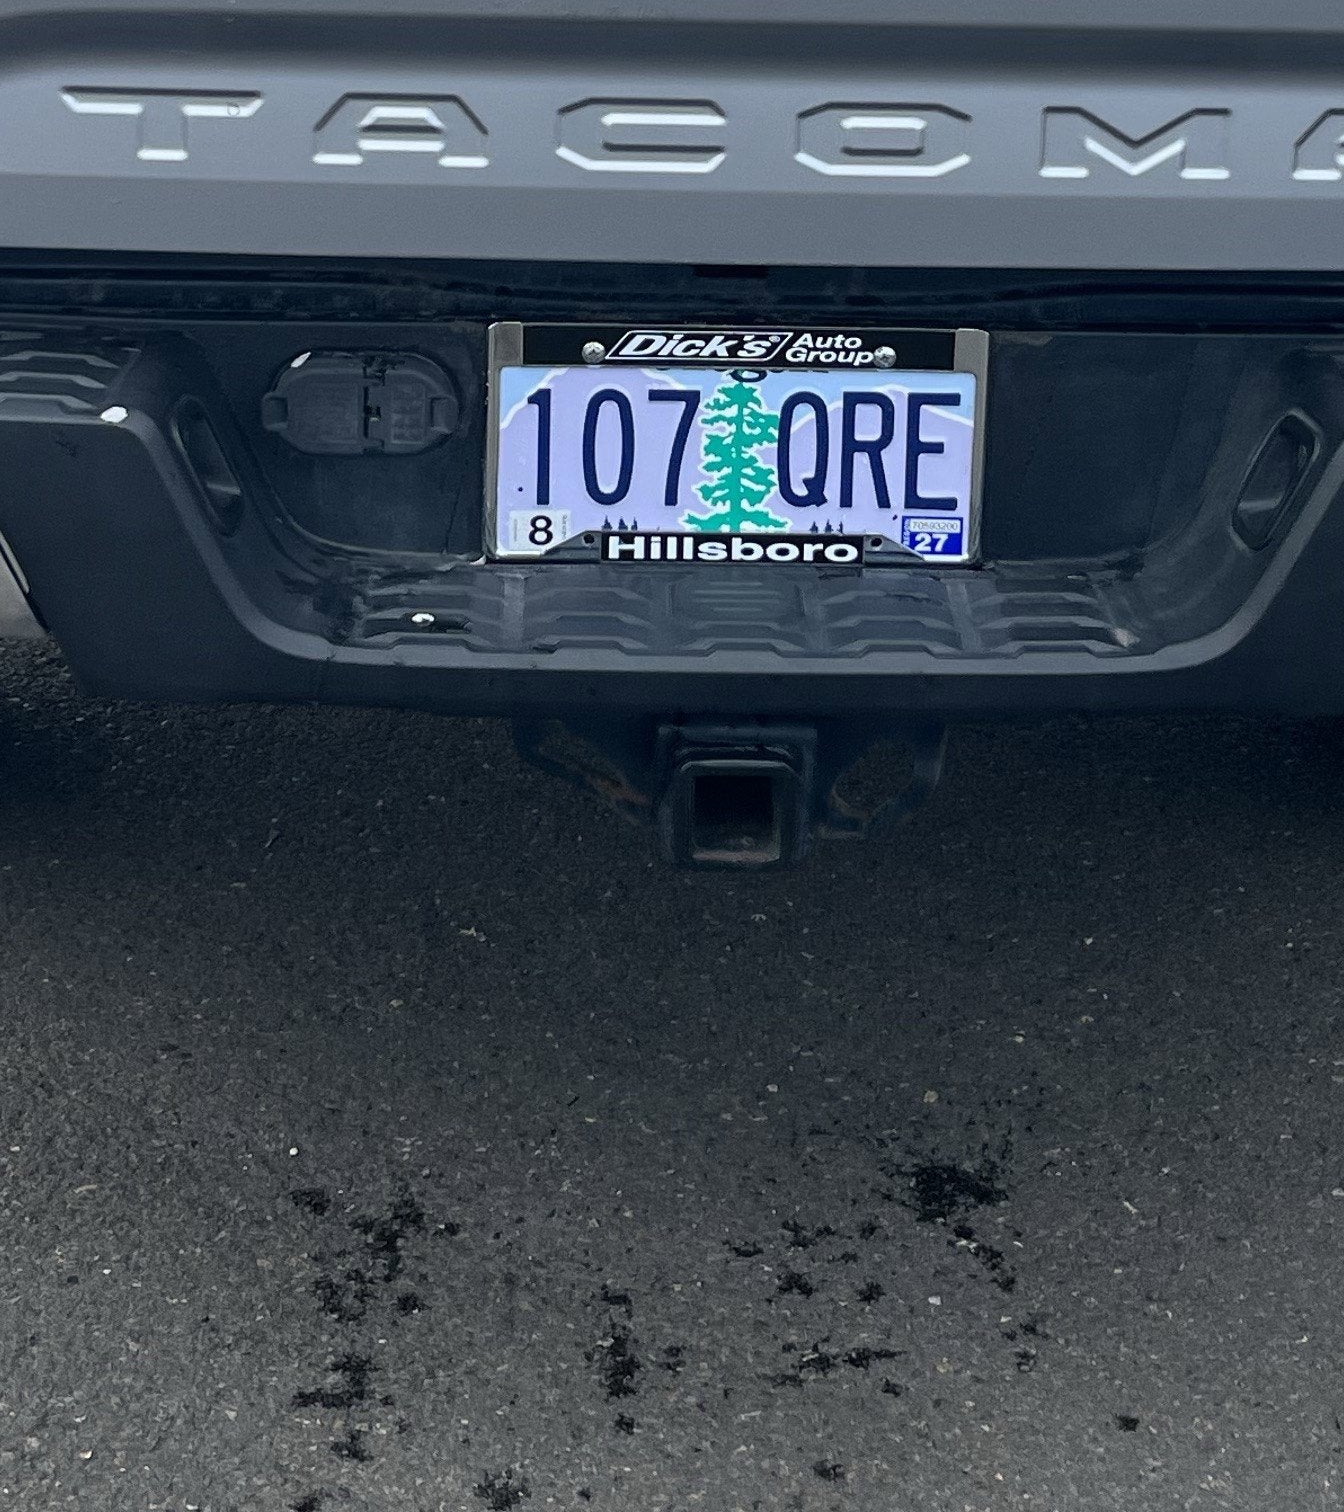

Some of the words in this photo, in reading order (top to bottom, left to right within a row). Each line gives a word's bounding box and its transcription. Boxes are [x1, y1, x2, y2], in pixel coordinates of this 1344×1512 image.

[618, 334, 772, 357] Dick's
[792, 333, 862, 349] Auto
[785, 347, 874, 366] Group
[527, 388, 701, 506] 107
[776, 392, 961, 510] QRE
[529, 515, 553, 546] 8
[607, 536, 859, 562] Hillsboro
[914, 533, 949, 552] 27
